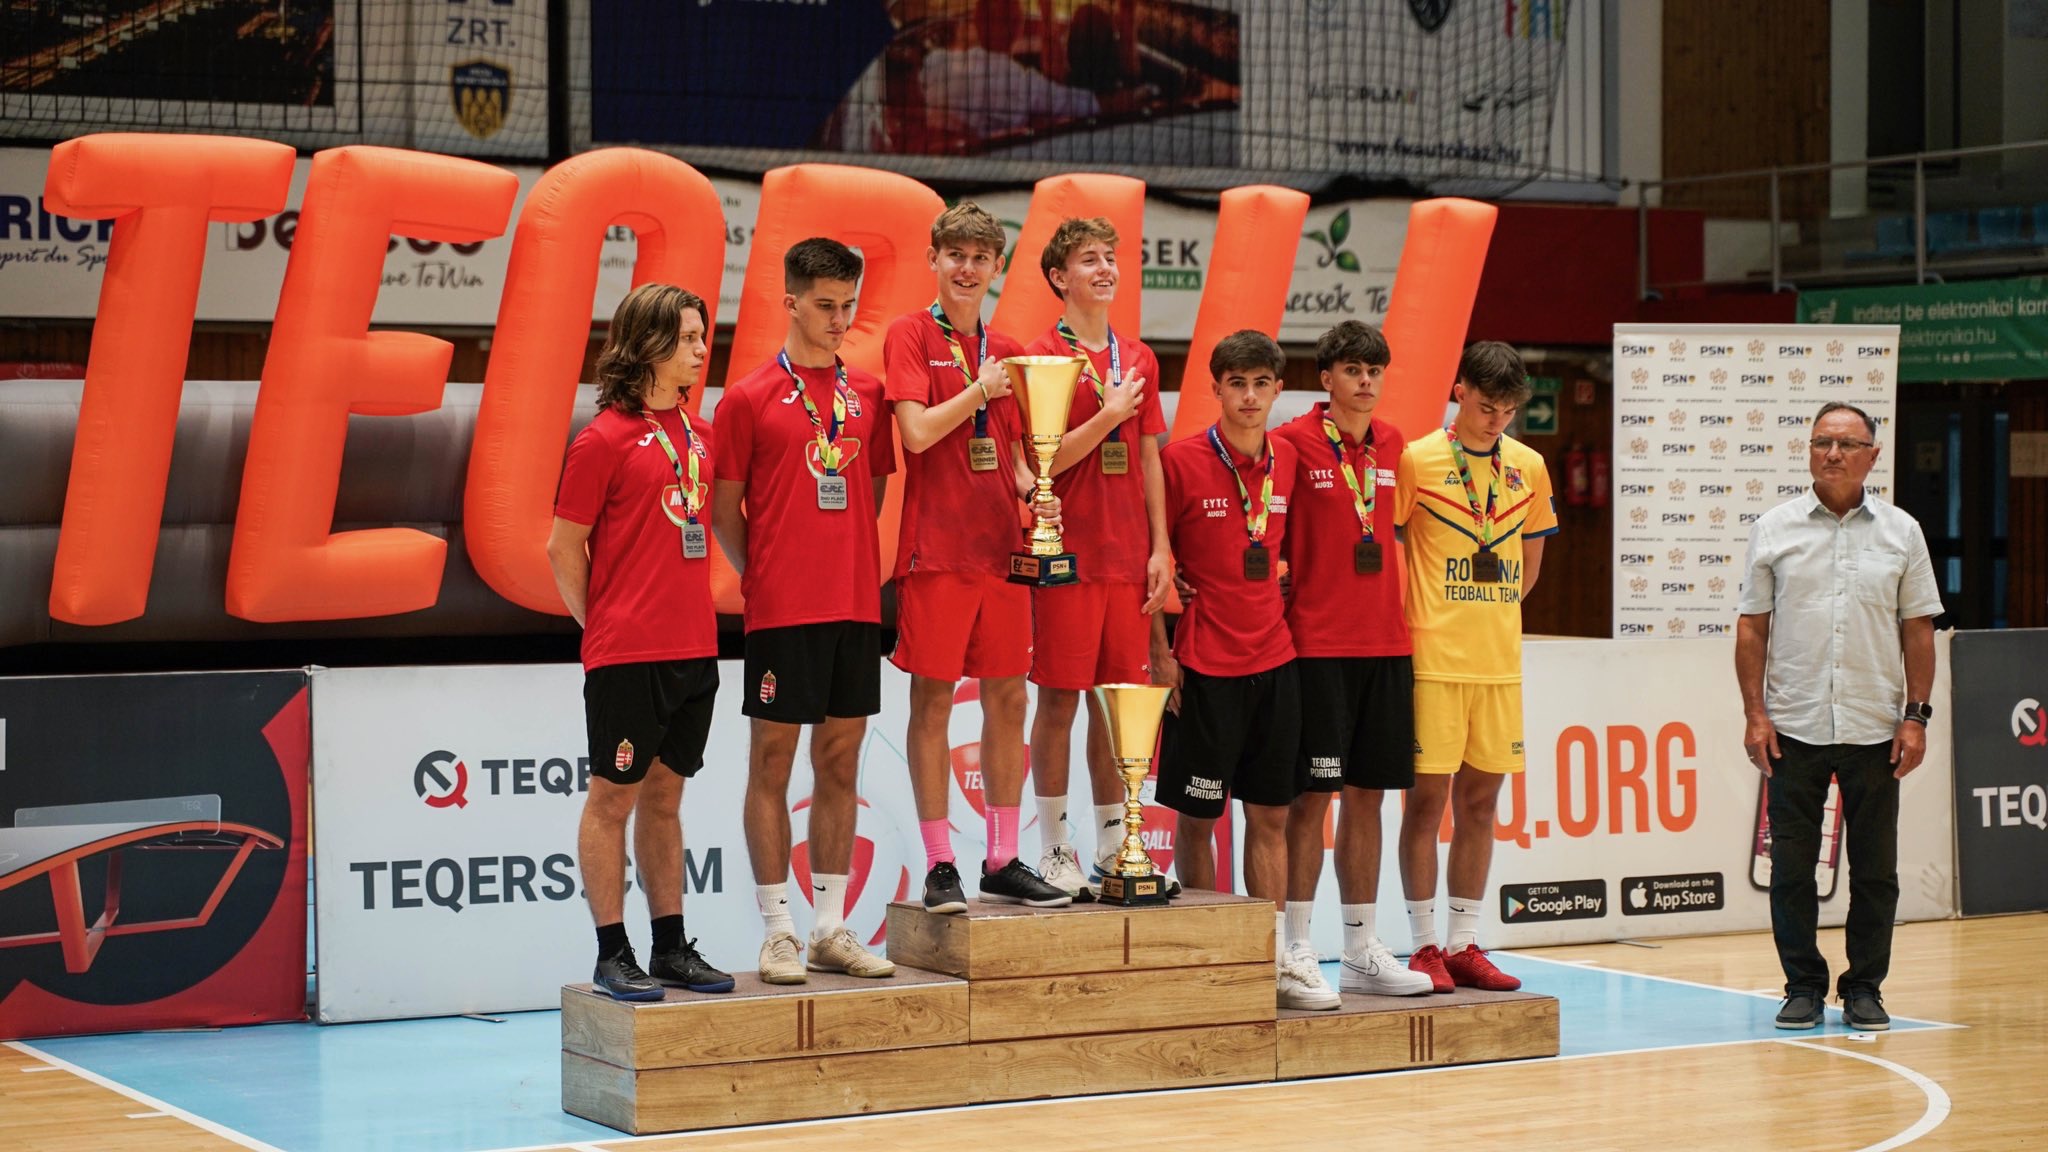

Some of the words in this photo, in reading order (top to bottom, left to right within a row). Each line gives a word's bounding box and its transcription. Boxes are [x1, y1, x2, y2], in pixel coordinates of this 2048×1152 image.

[447, 17, 516, 46] ZRT.
[1905, 303, 1924, 321] be
[1927, 297, 2014, 320] elektronikai
[1622, 346, 1647, 355] PSN
[1701, 346, 1725, 355] PSN
[1779, 346, 1804, 355] PSN
[1858, 347, 1882, 356] PSN
[1663, 374, 1687, 383] PSN
[1741, 375, 1765, 384] PSN
[1820, 375, 1844, 384] PSN
[1621, 416, 1646, 424] PSN
[1700, 416, 1725, 424] PSN
[1778, 416, 1803, 425] PSN
[1662, 444, 1687, 453] PSN
[1740, 444, 1765, 453] PSN
[1309, 469, 1335, 480] EYTC
[1314, 481, 1334, 489] AUG25
[1621, 485, 1646, 493] PSN
[1700, 485, 1724, 493] PSN
[1778, 486, 1802, 494] PSN
[1203, 498, 1229, 509] EYTC
[1207, 510, 1227, 518] AUG25
[1662, 514, 1687, 522] PSN
[1621, 555, 1646, 563] PSN
[1700, 555, 1723, 563] PSN
[1446, 557, 1520, 585] RONIA
[1662, 583, 1686, 592] PSN
[1445, 585, 1497, 603] TEQBALL
[1499, 586, 1520, 604] TEAM
[1621, 624, 1645, 632] PSN
[1699, 624, 1723, 632] PSN
[1191, 776, 1223, 790] TEQBALL
[1185, 785, 1223, 800] PORTUGAL
[350, 847, 723, 912] TEQERS.M
[1653, 880, 1690, 890] Download
[1691, 880, 1702, 888] on
[1702, 878, 1714, 887] the
[1528, 887, 1542, 896] GET
[1542, 887, 1548, 895] IT
[1548, 886, 1560, 894] ON
[1653, 891, 1680, 910] App
[1682, 890, 1716, 905] Store
[1528, 896, 1573, 916] Google
[1574, 895, 1602, 913] Play
